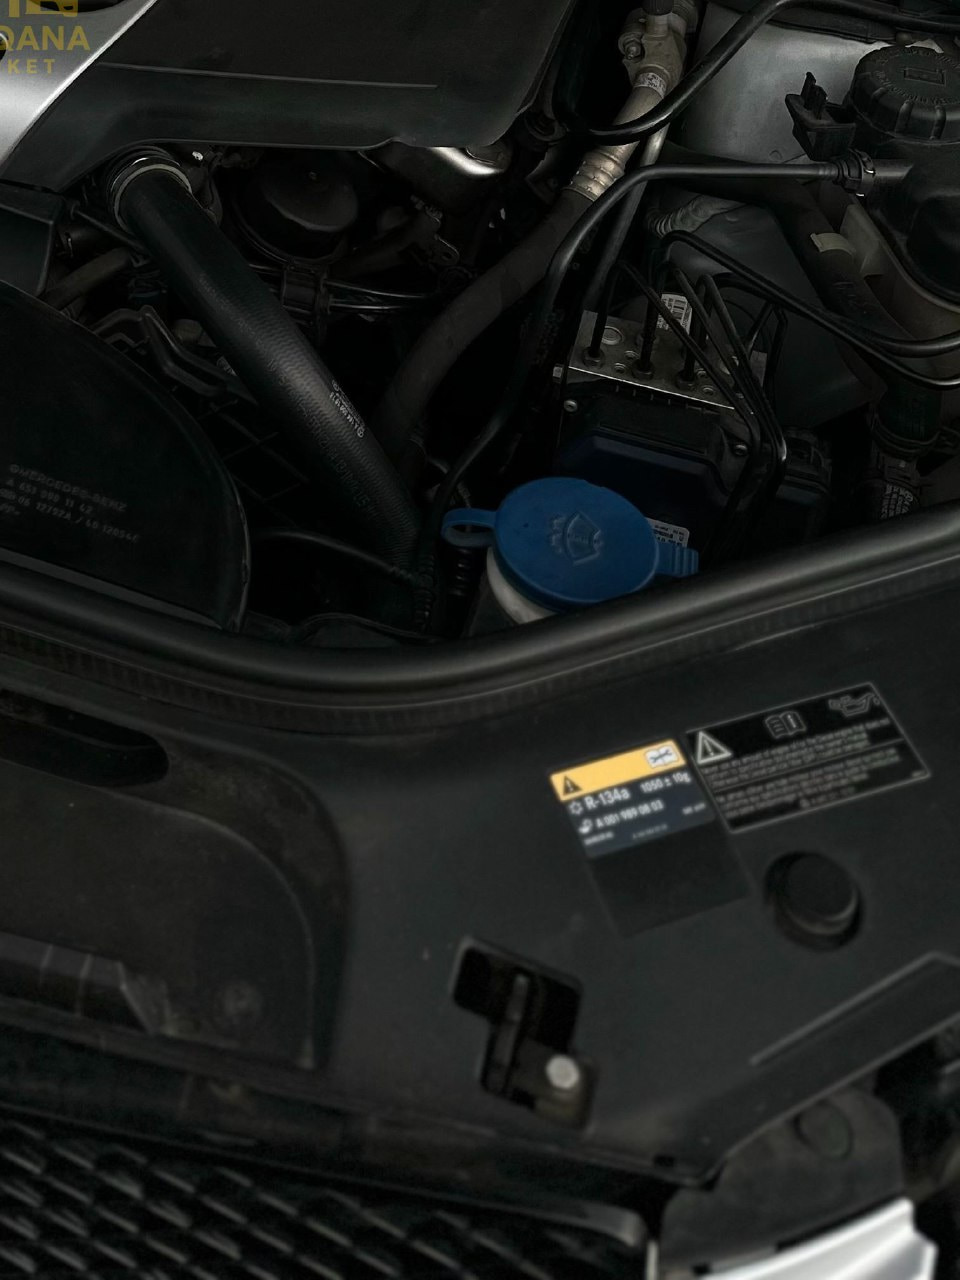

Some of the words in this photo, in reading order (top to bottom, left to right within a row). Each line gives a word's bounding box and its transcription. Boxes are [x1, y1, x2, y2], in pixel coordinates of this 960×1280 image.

[584, 787, 632, 810] R-134a
[640, 778, 664, 794] 1050
[595, 818, 603, 829] A
